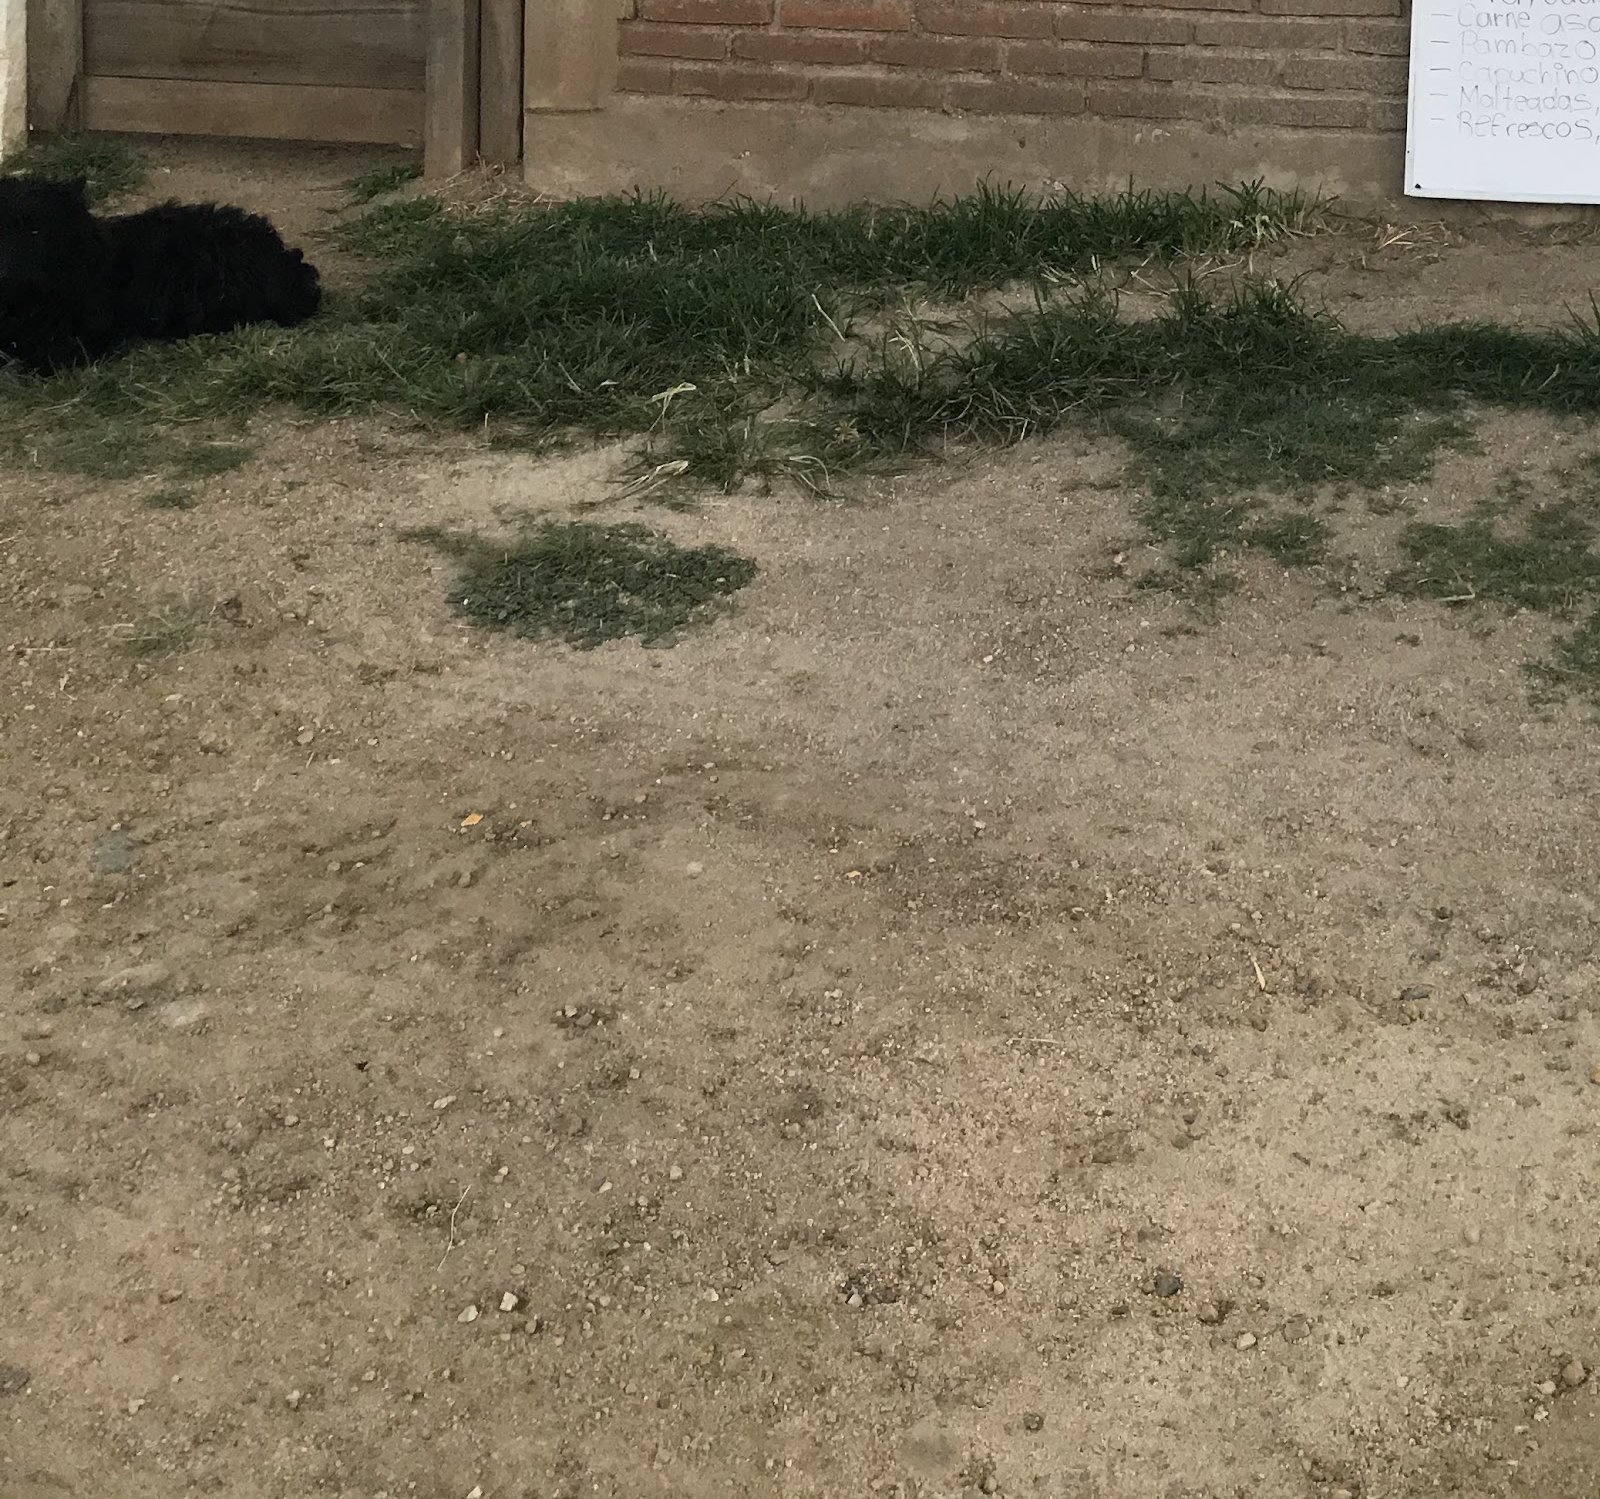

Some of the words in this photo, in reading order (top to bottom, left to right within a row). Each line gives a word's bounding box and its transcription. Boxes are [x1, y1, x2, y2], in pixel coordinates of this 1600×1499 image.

[1457, 3, 1531, 29] Carne
[1459, 29, 1597, 60] Pambazo
[1458, 60, 1600, 89] Capuchino
[1458, 84, 1600, 115] Malteadas,
